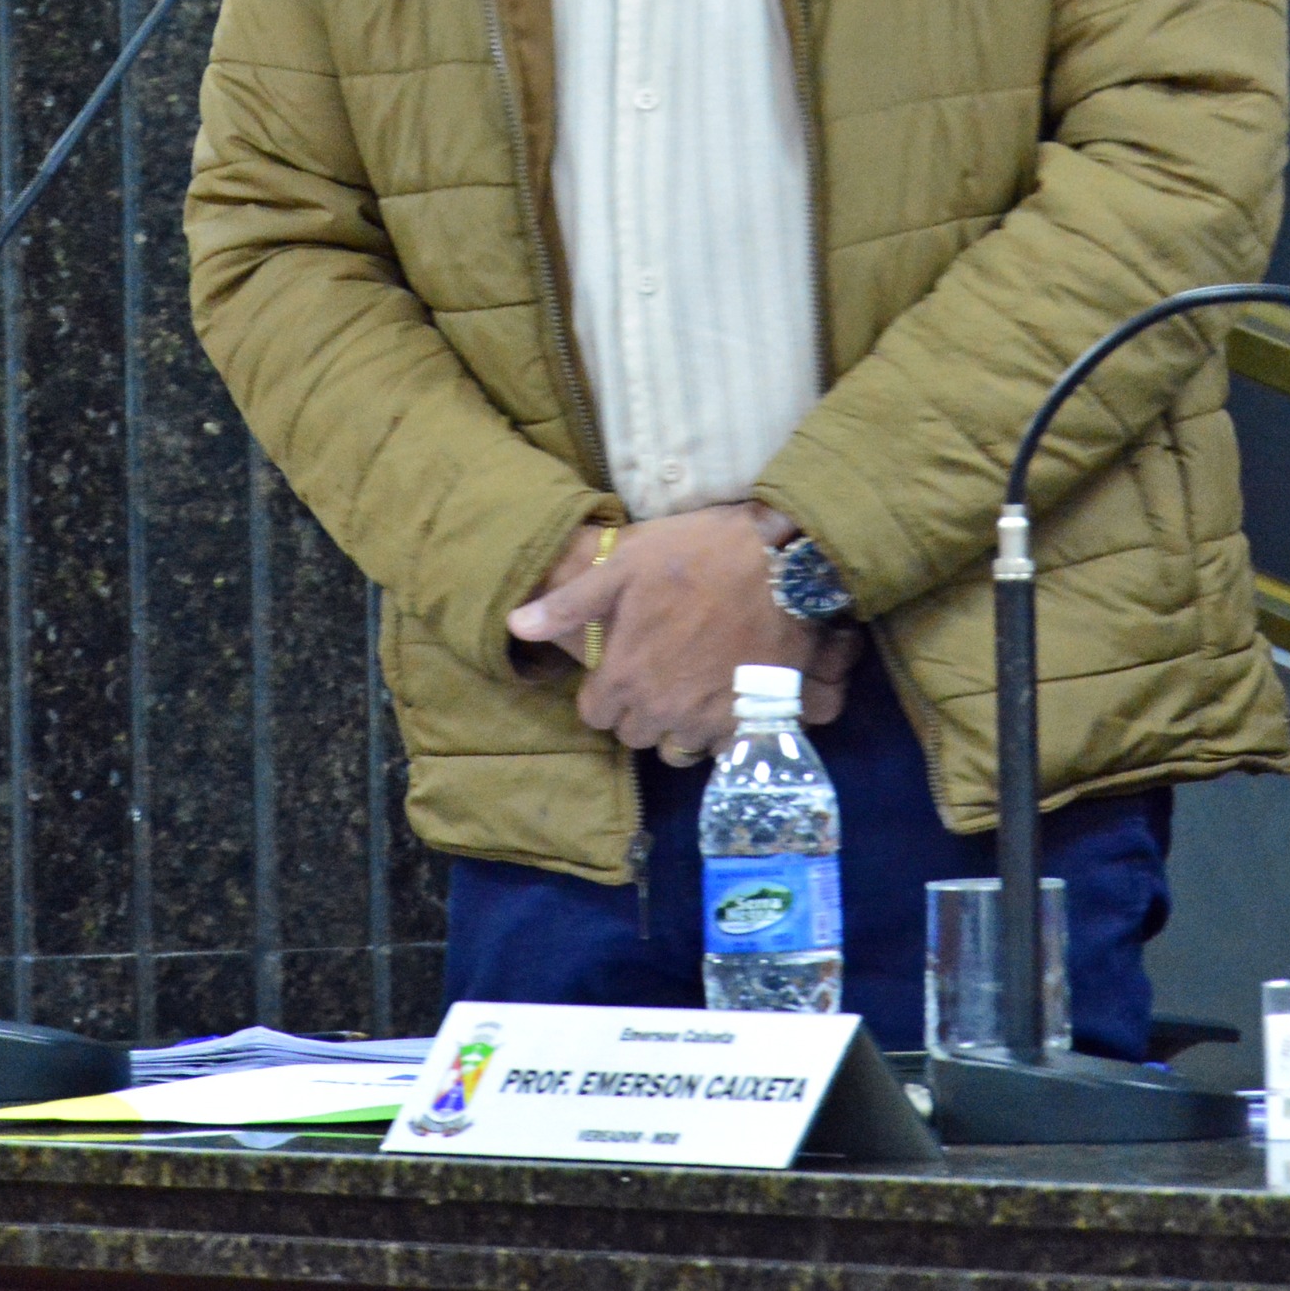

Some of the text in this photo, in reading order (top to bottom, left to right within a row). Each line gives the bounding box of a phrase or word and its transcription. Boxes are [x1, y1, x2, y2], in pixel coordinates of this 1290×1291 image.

[620, 1027, 736, 1044] Emerson Caixeta
[499, 1069, 809, 1102] PROF. EMERSON CAIXETA
